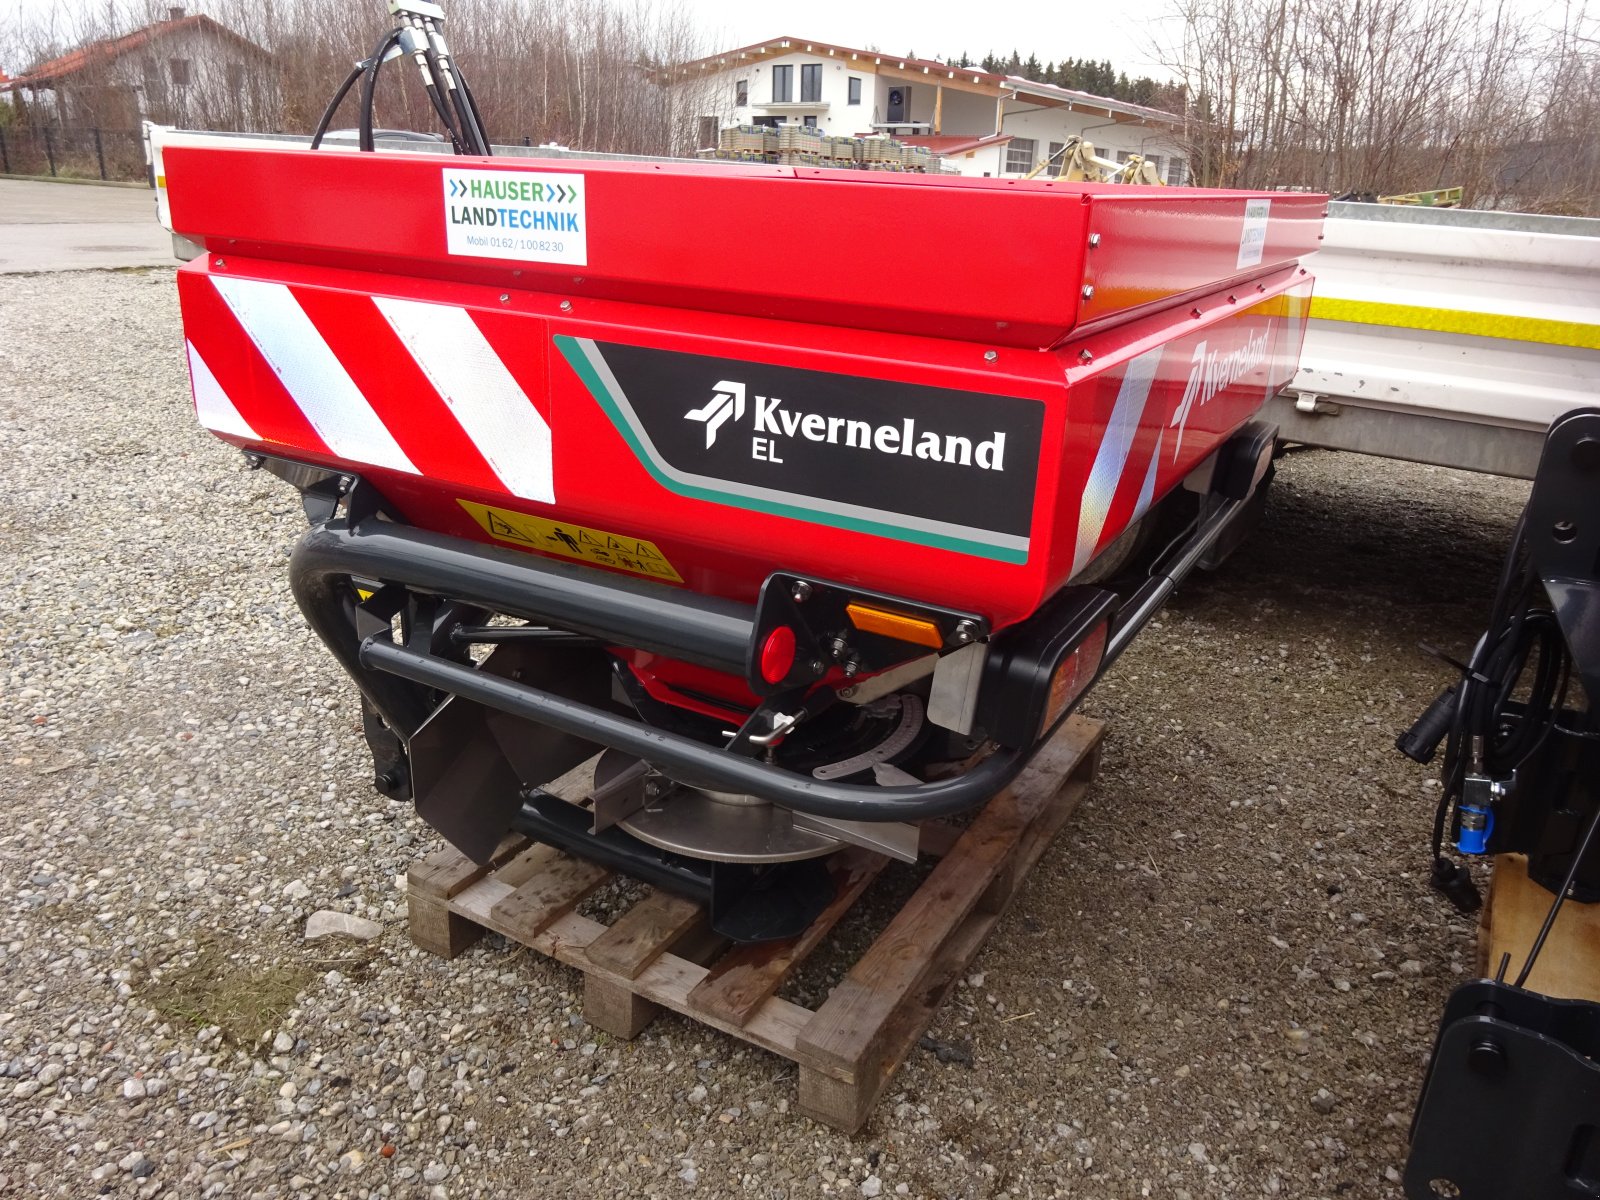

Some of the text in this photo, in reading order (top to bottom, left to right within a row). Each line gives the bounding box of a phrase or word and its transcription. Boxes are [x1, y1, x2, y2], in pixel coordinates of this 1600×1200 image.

[470, 179, 544, 202] HAUSER
[450, 205, 580, 233] LANDTECHNIK
[466, 235, 488, 246] Mobil
[1200, 318, 1271, 407] Kverneland
[753, 395, 1006, 472] Kverneland
[752, 437, 784, 464] EL
